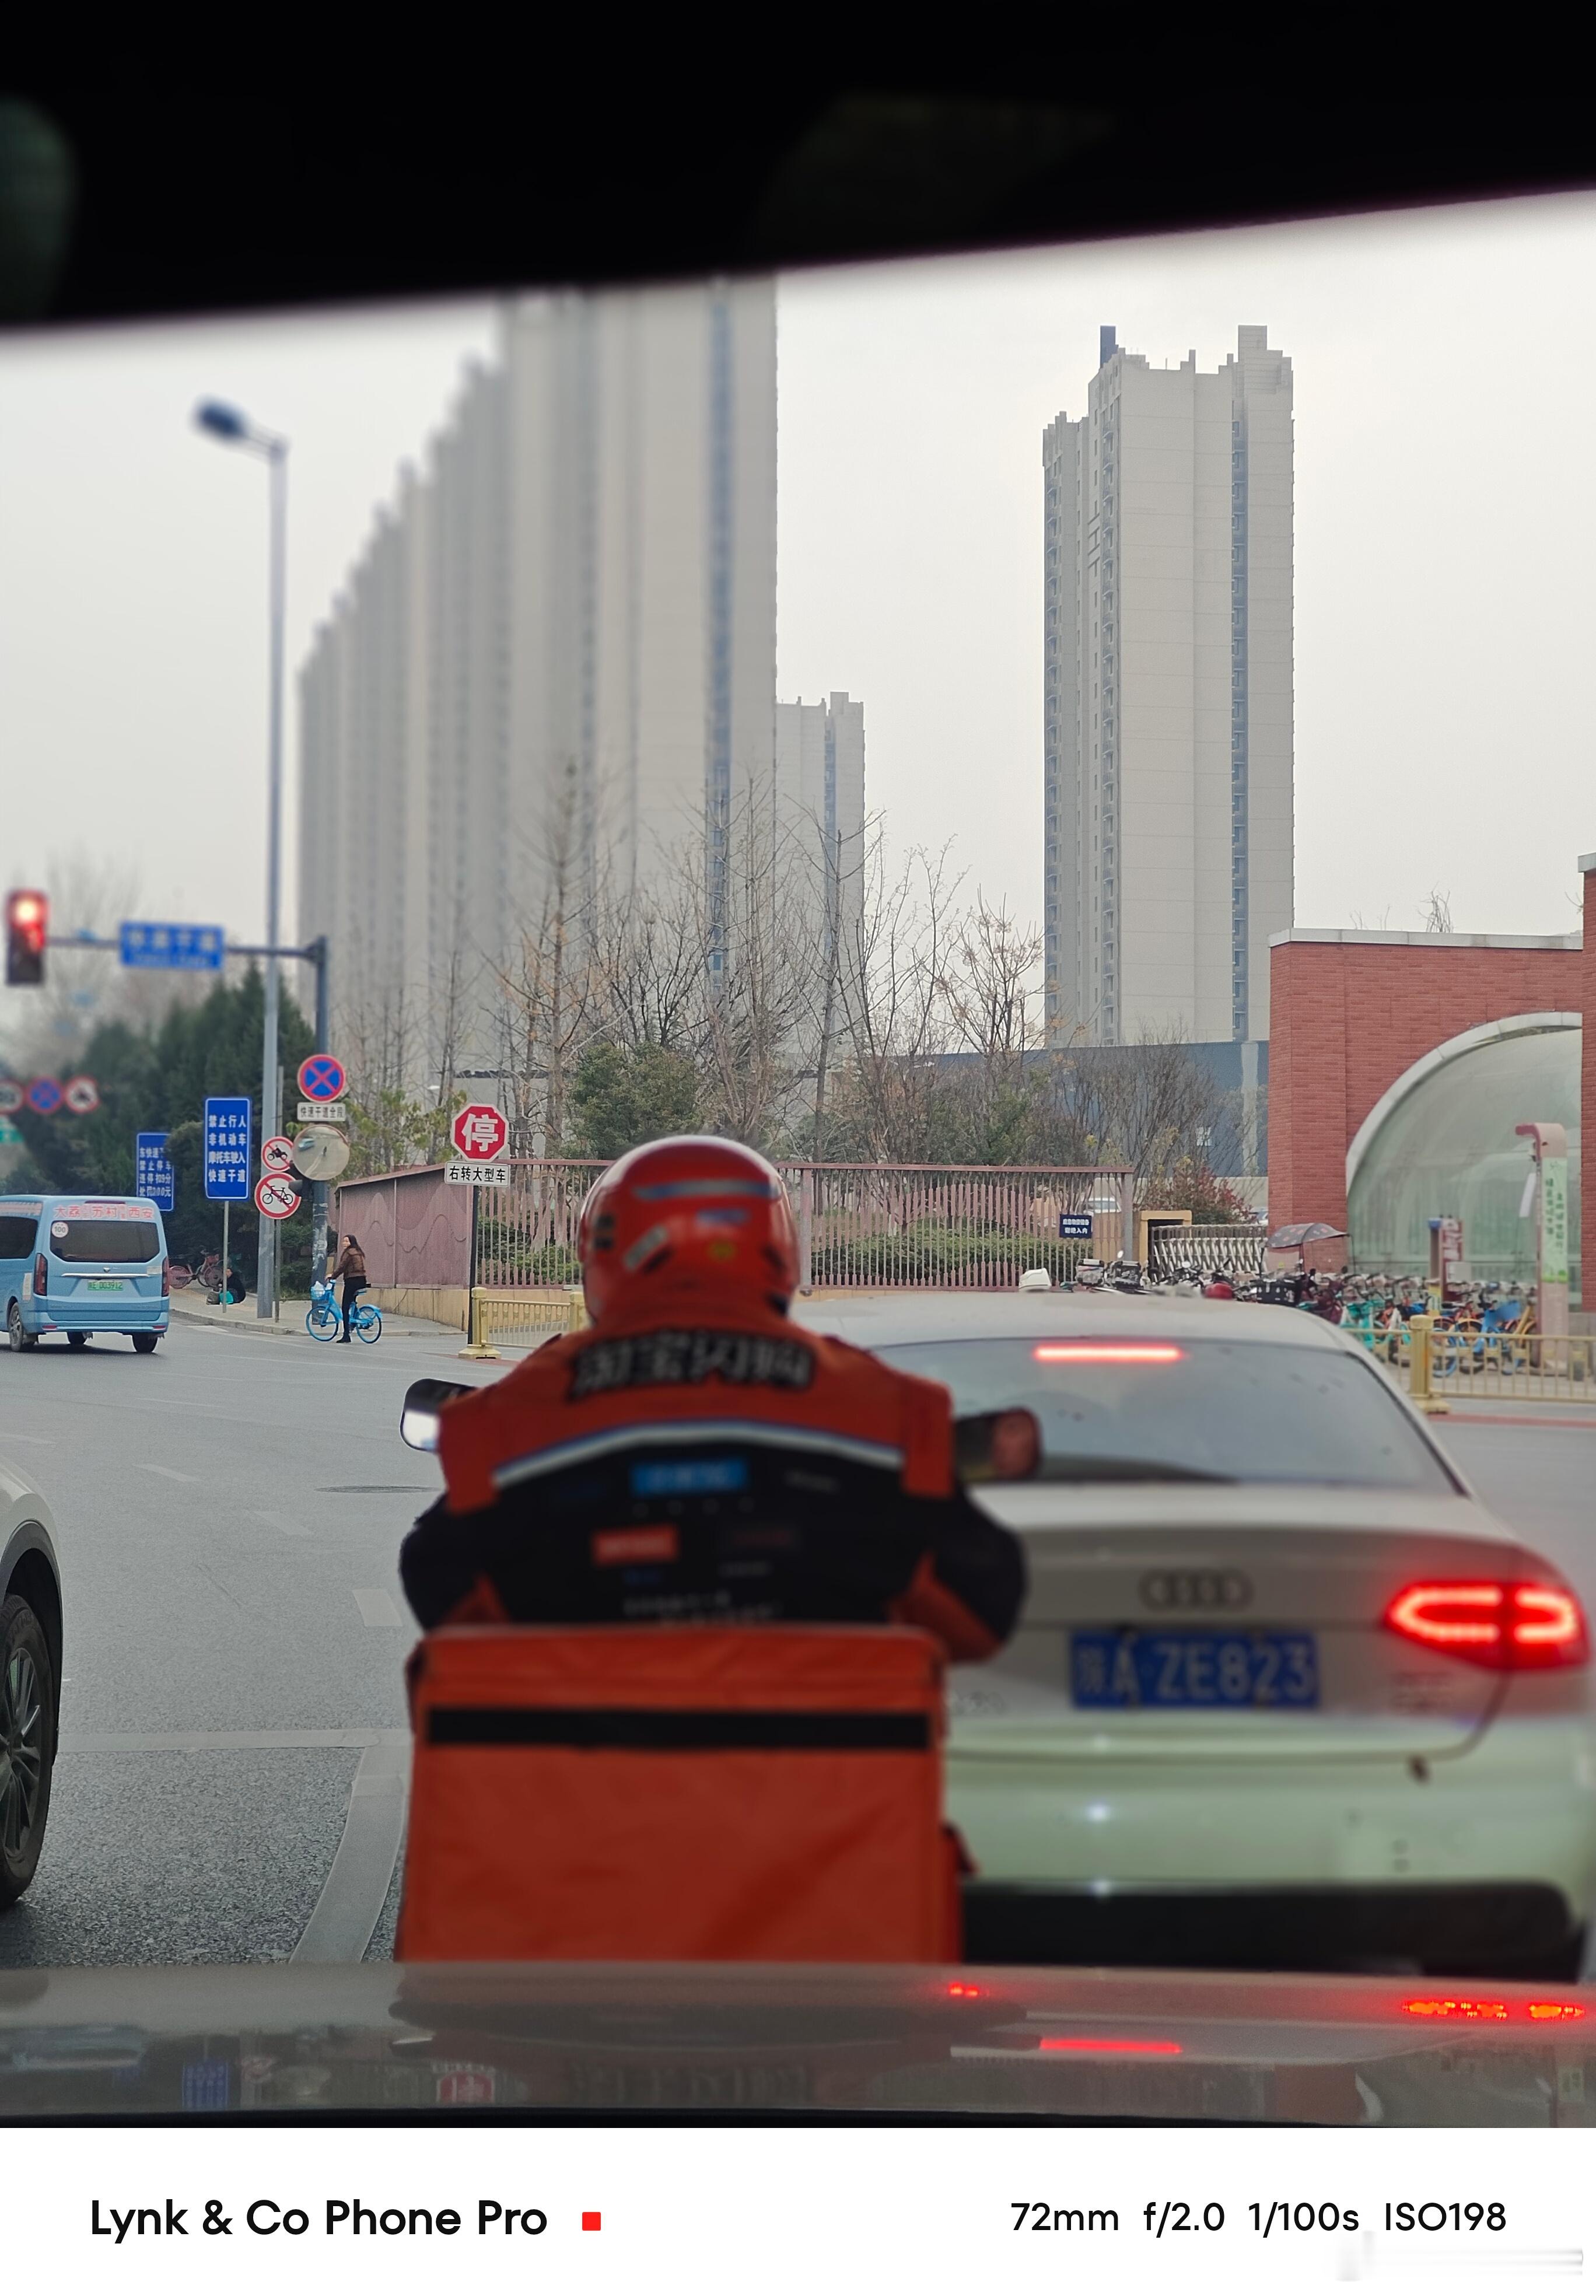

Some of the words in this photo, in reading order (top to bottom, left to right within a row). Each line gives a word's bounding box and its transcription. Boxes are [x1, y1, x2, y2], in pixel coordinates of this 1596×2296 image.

[208, 1114, 247, 1128] 禁止行人
[208, 1132, 247, 1146] 非机动车
[461, 1112, 499, 1152] 停
[208, 1151, 246, 1164] 摩托车驶入
[208, 1169, 246, 1183] 快速干道
[449, 1165, 506, 1184] 右转大型车
